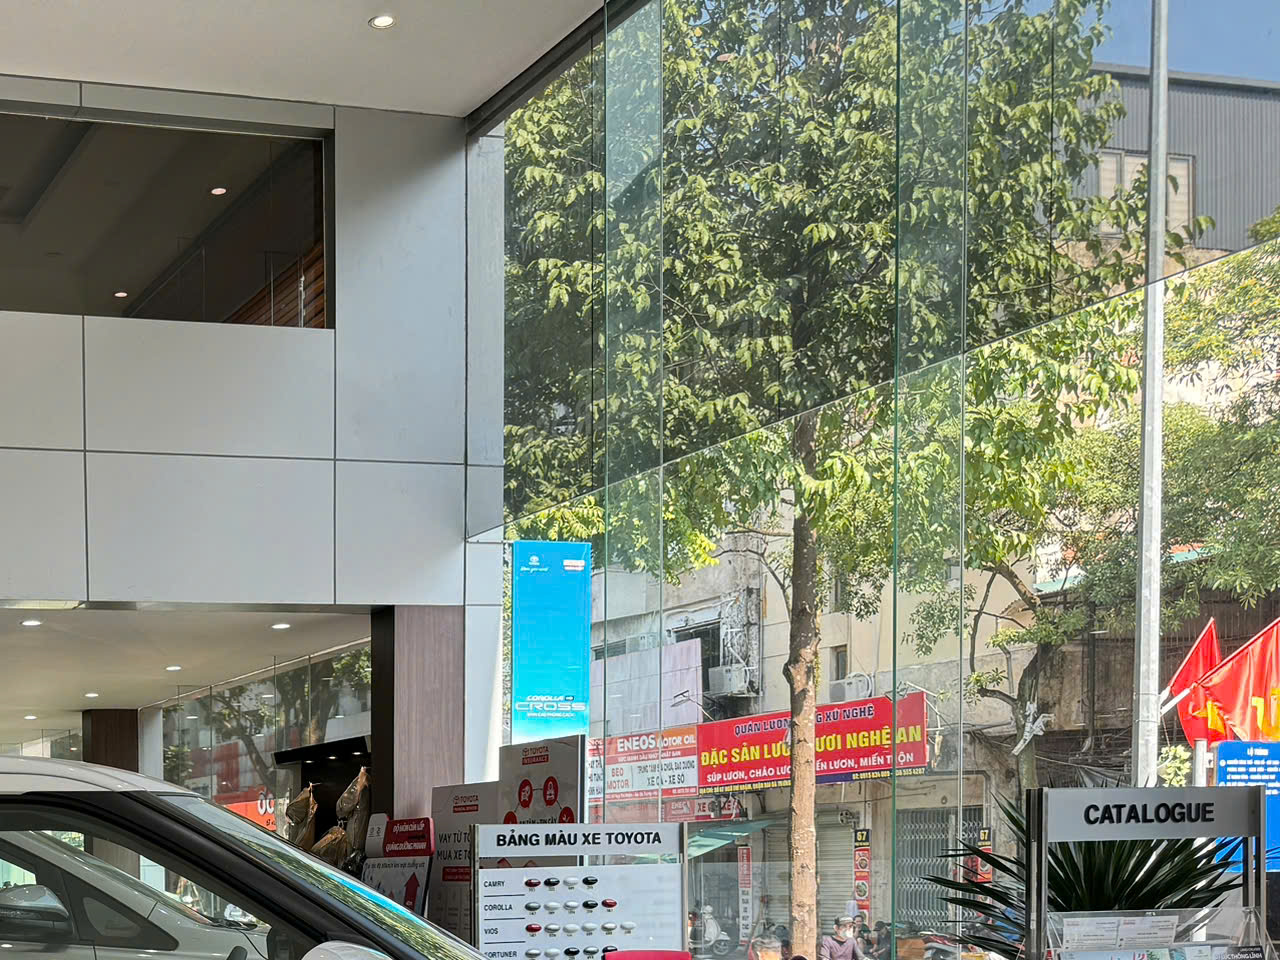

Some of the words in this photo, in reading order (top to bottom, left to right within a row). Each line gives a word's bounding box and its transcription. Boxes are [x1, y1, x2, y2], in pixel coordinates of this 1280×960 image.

[515, 701, 587, 712] CROSS
[842, 703, 875, 719] NGHỆ
[616, 734, 657, 753] ENEOS
[815, 733, 843, 753] ƯƠI
[845, 725, 892, 749] NGHỆ
[895, 724, 922, 744] AN
[700, 747, 729, 769] ĐẶC
[730, 741, 761, 763] SẢN
[860, 752, 886, 767] MIẾN
[886, 750, 914, 765] TỘN
[607, 779, 630, 790] MOTOR
[668, 775, 676, 785] XE
[1083, 802, 1215, 825] CATALOGUE
[438, 832, 453, 844] VAY
[496, 828, 541, 847] BẢNG
[544, 829, 578, 846] MÀU
[582, 832, 602, 845] XE
[606, 831, 662, 845] TOYOTA
[856, 831, 867, 841] 67
[979, 830, 989, 841] 67
[437, 849, 453, 861] MUA
[453, 848, 464, 860] XE
[483, 880, 505, 888] CAMRY
[483, 904, 513, 912] COROLLA
[484, 927, 499, 935] VIOS
